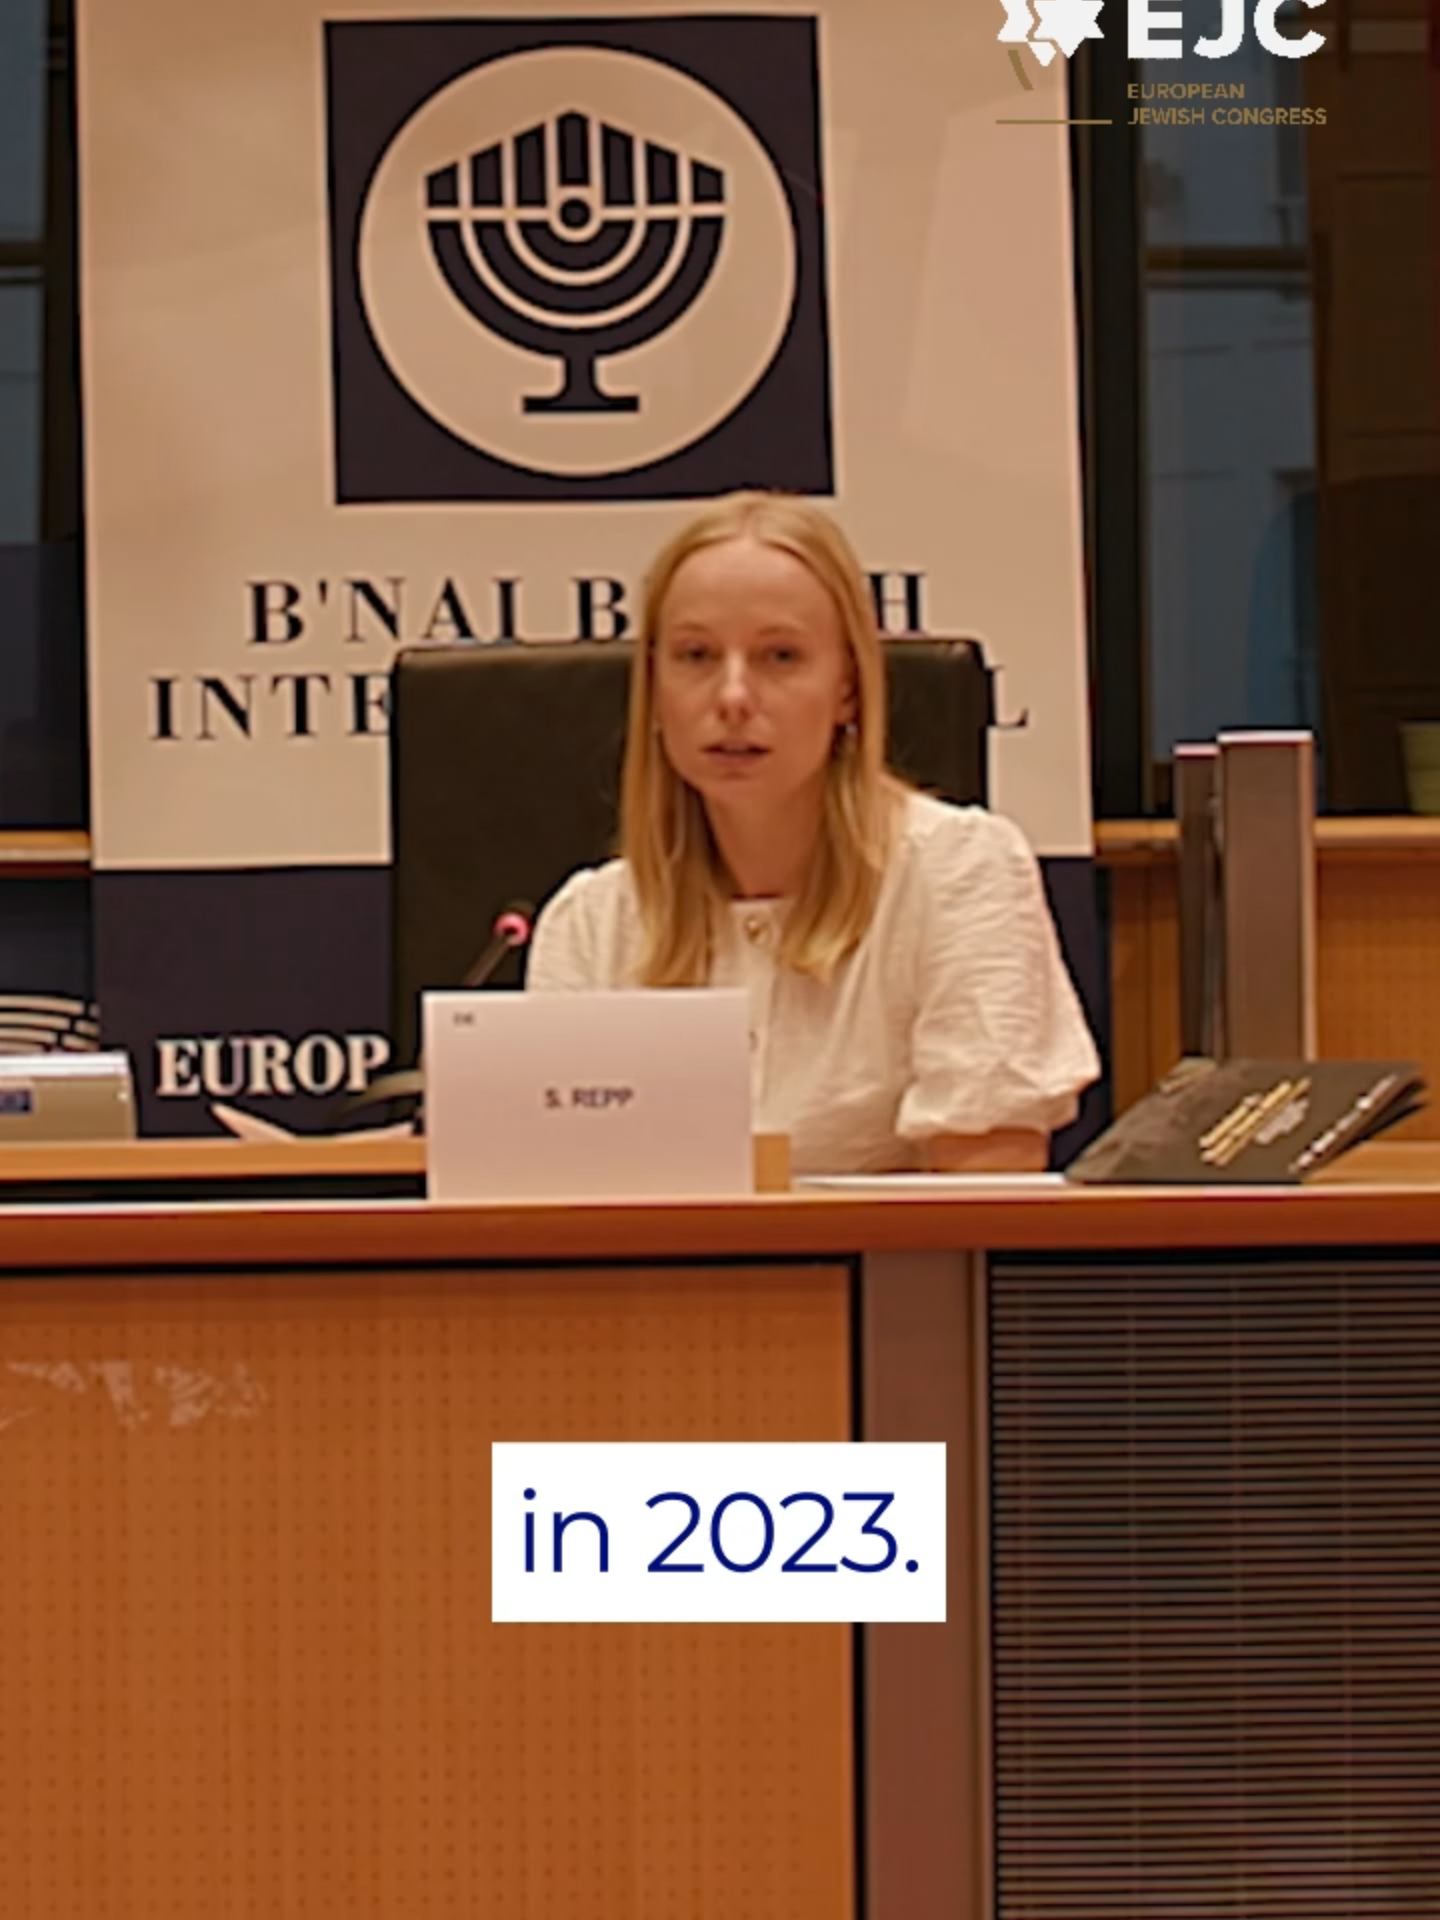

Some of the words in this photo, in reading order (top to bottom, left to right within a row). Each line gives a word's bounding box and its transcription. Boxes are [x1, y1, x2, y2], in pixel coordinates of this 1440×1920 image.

[246, 576, 522, 644] B'NAI
[155, 1034, 391, 1096] EUROP
[571, 1086, 634, 1110] REPP
